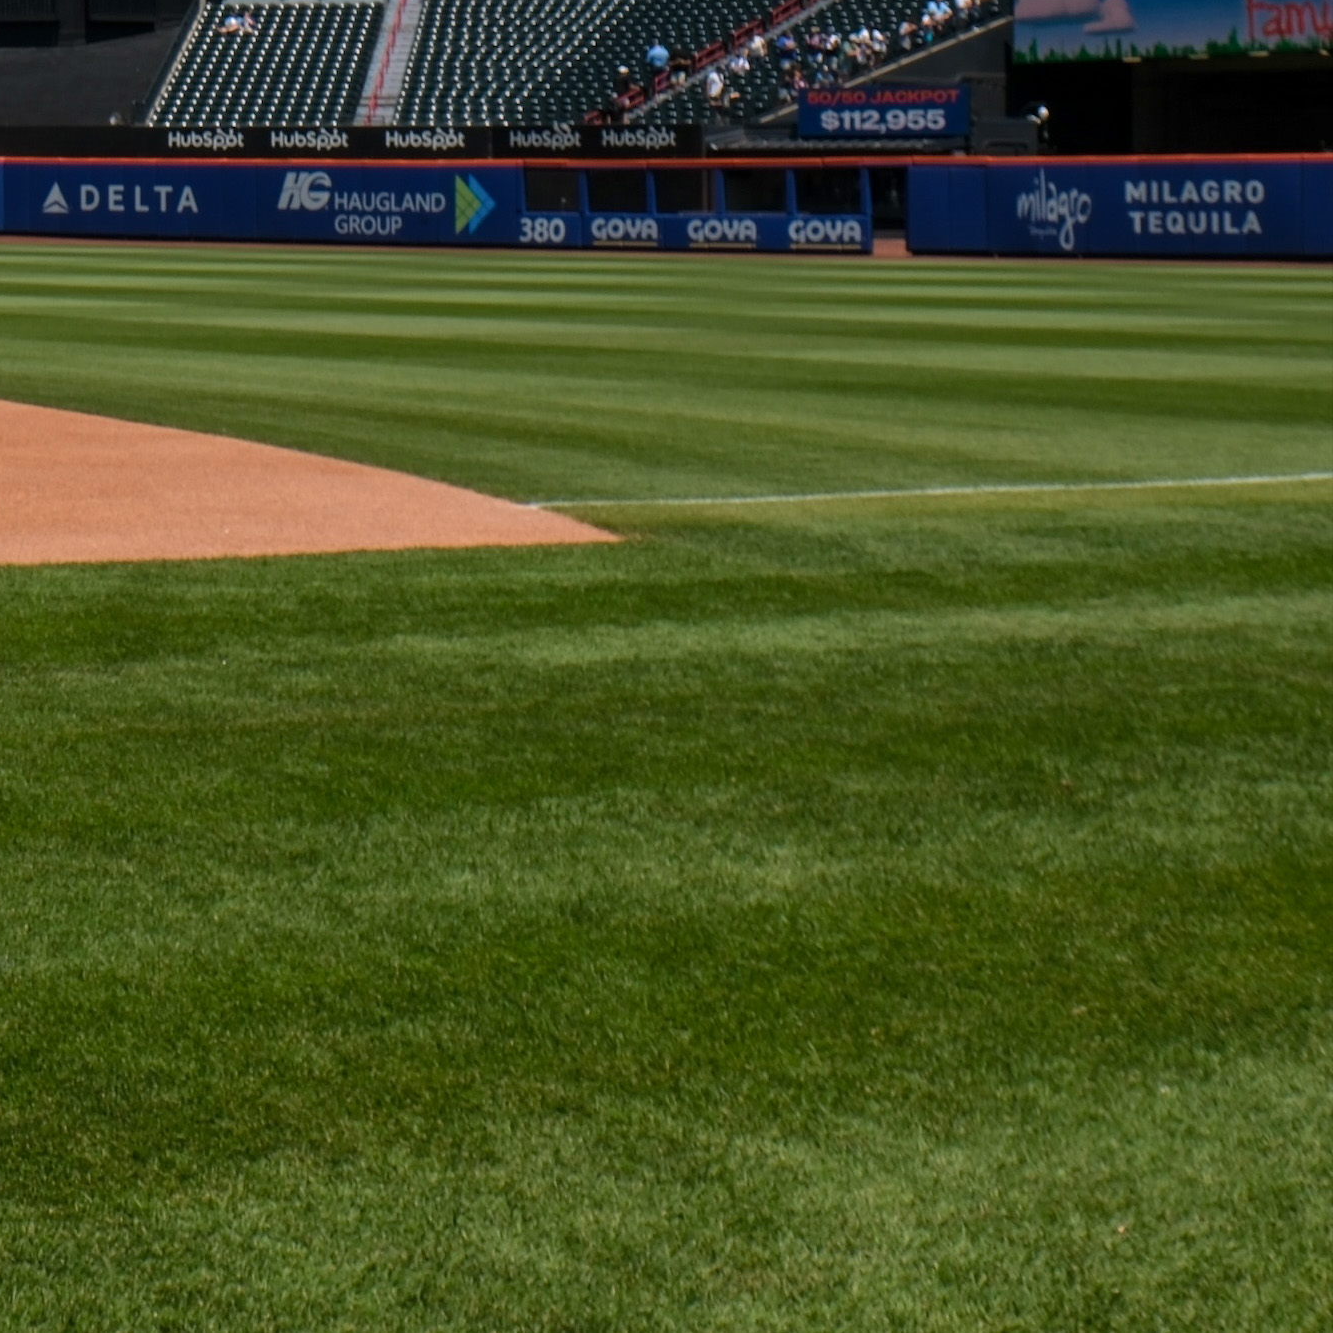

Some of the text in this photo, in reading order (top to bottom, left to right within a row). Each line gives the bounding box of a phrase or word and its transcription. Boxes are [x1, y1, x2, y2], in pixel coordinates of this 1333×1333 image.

[807, 88, 961, 105] 50/50 JACKPOT
[820, 107, 946, 135] $112,955
[167, 127, 244, 151] HubSpot
[270, 127, 349, 151] HubSpot
[385, 127, 466, 151] HubSpot
[509, 122, 582, 151] HubSpot
[601, 126, 677, 151] HubSpot
[80, 183, 199, 214] DELTA
[334, 191, 446, 214] HAUGLAND
[1124, 180, 1266, 204] MILAGRO
[1017, 168, 1092, 252] milagro
[1129, 210, 1263, 235] TEQUILA
[334, 215, 403, 237] GROUP
[518, 217, 566, 244] 380
[590, 218, 659, 242] GOYA
[687, 218, 758, 243] GOYA
[788, 218, 862, 244] GOYA
